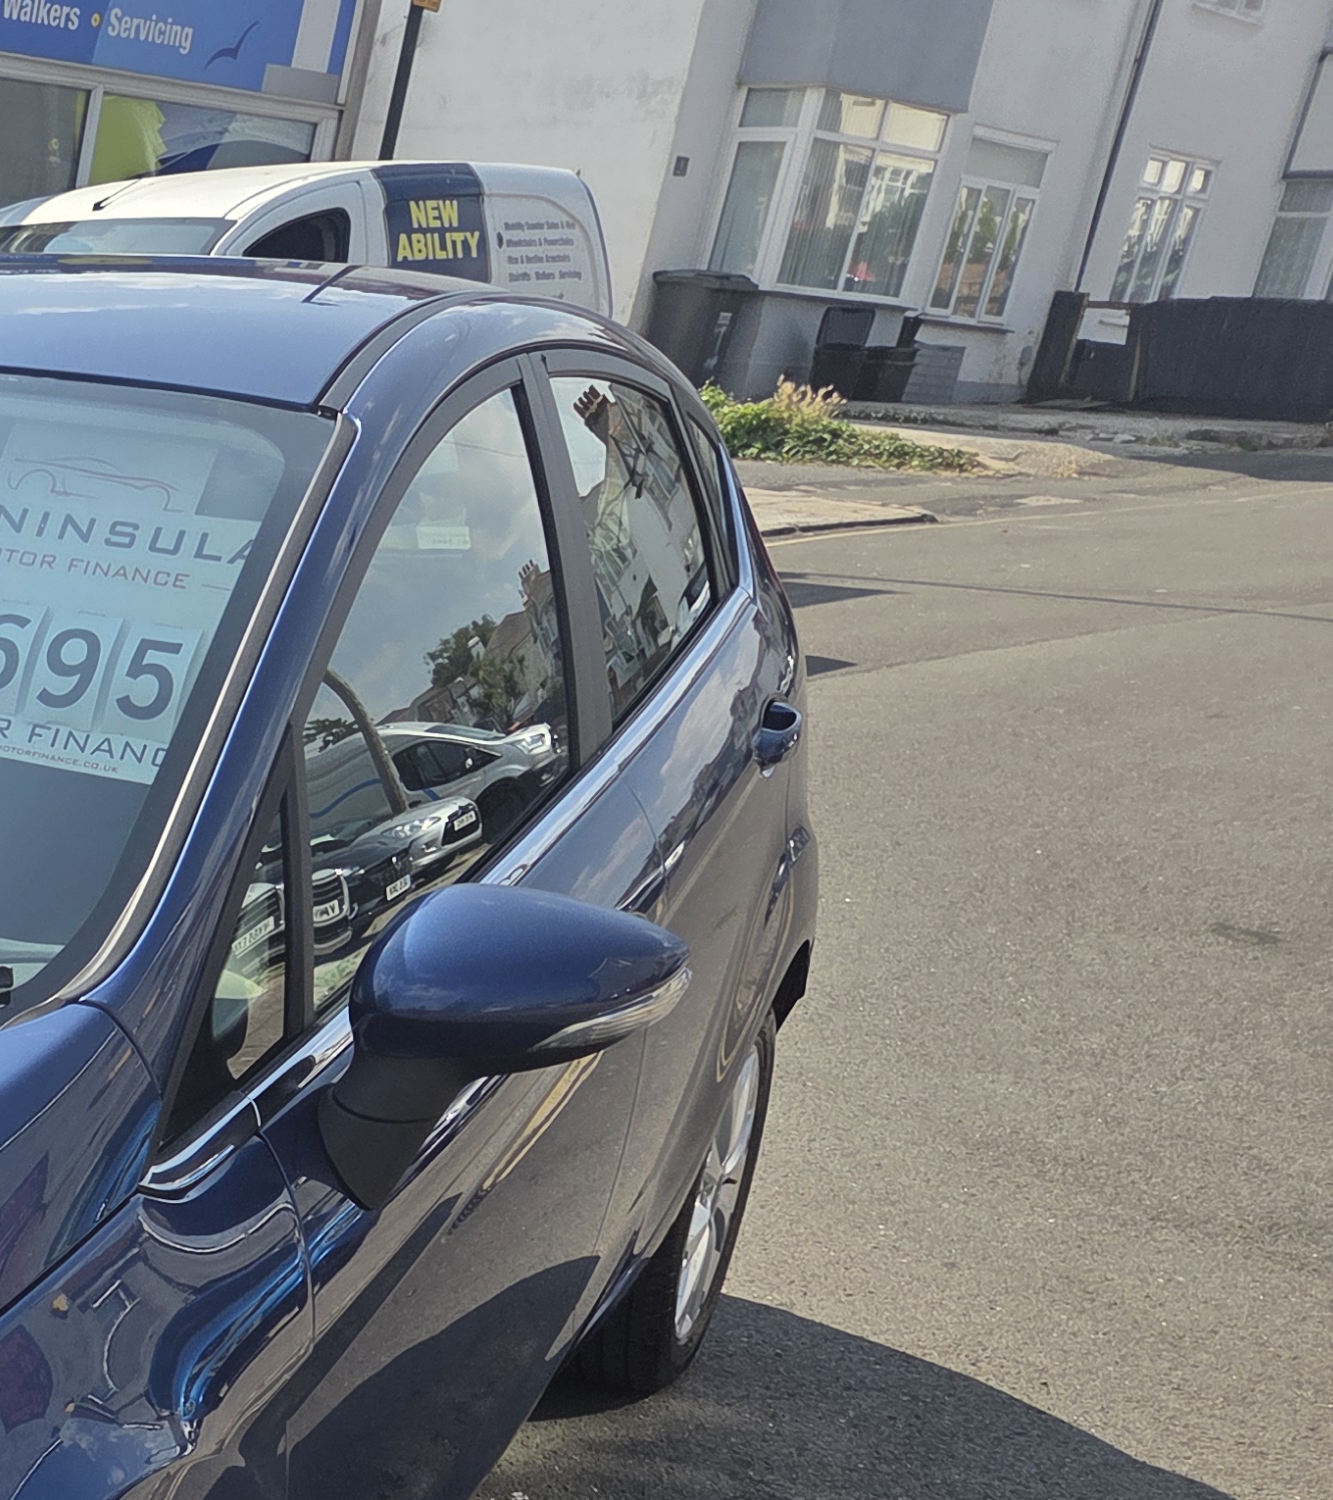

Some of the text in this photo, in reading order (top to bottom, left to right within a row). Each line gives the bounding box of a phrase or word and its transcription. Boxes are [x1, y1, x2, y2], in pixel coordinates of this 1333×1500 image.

[2, 0, 194, 55] Walkers Servicing
[409, 199, 459, 229] NEW
[396, 231, 480, 262] ABILITY
[66, 557, 191, 591] FINANCE
